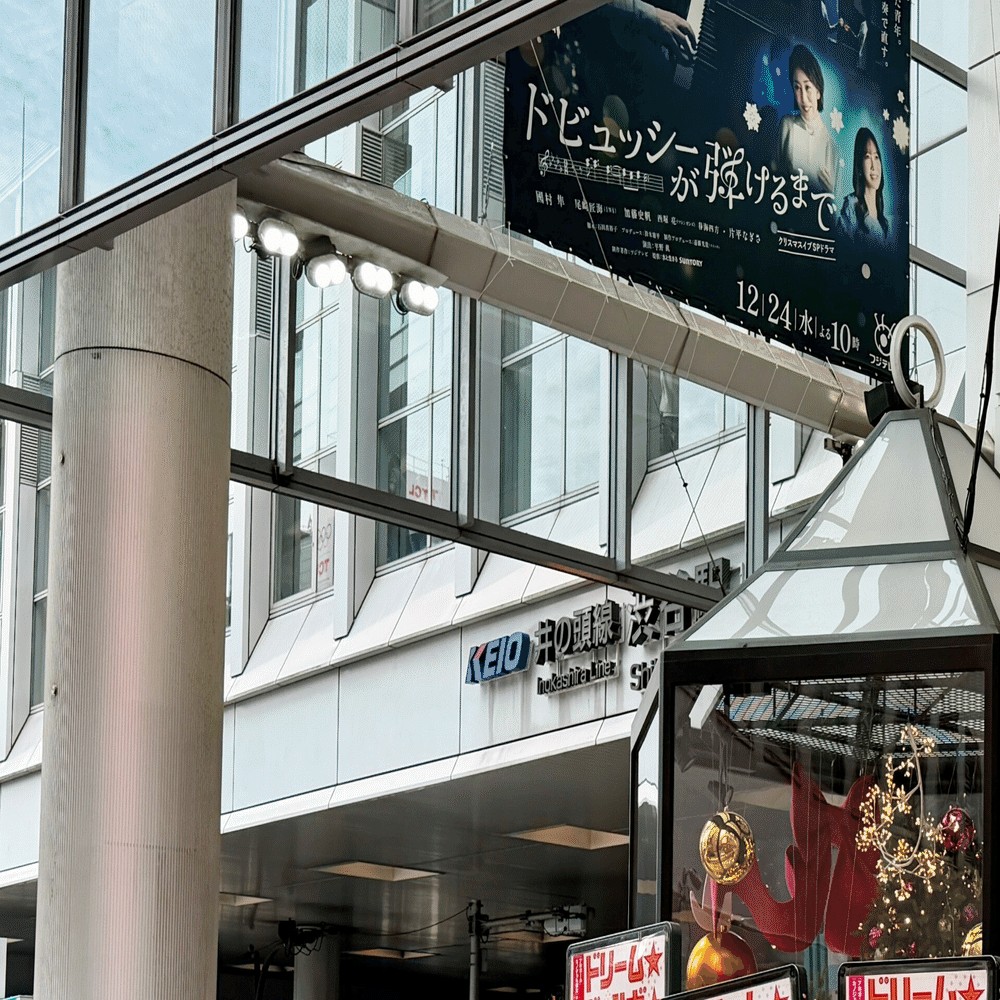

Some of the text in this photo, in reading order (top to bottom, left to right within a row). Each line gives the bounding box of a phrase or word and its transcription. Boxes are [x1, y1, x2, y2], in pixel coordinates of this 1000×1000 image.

[526, 83, 698, 165] ドビュッシー
[670, 141, 838, 232] が弾けるまで
[778, 236, 835, 254] クリスマスイブSPドラマ
[736, 280, 759, 317] 12
[768, 293, 792, 332] 24
[799, 309, 813, 336] 水
[465, 631, 531, 685] KEIO
[534, 600, 621, 665] 井の頭線
[537, 666, 590, 696] Inokashira
